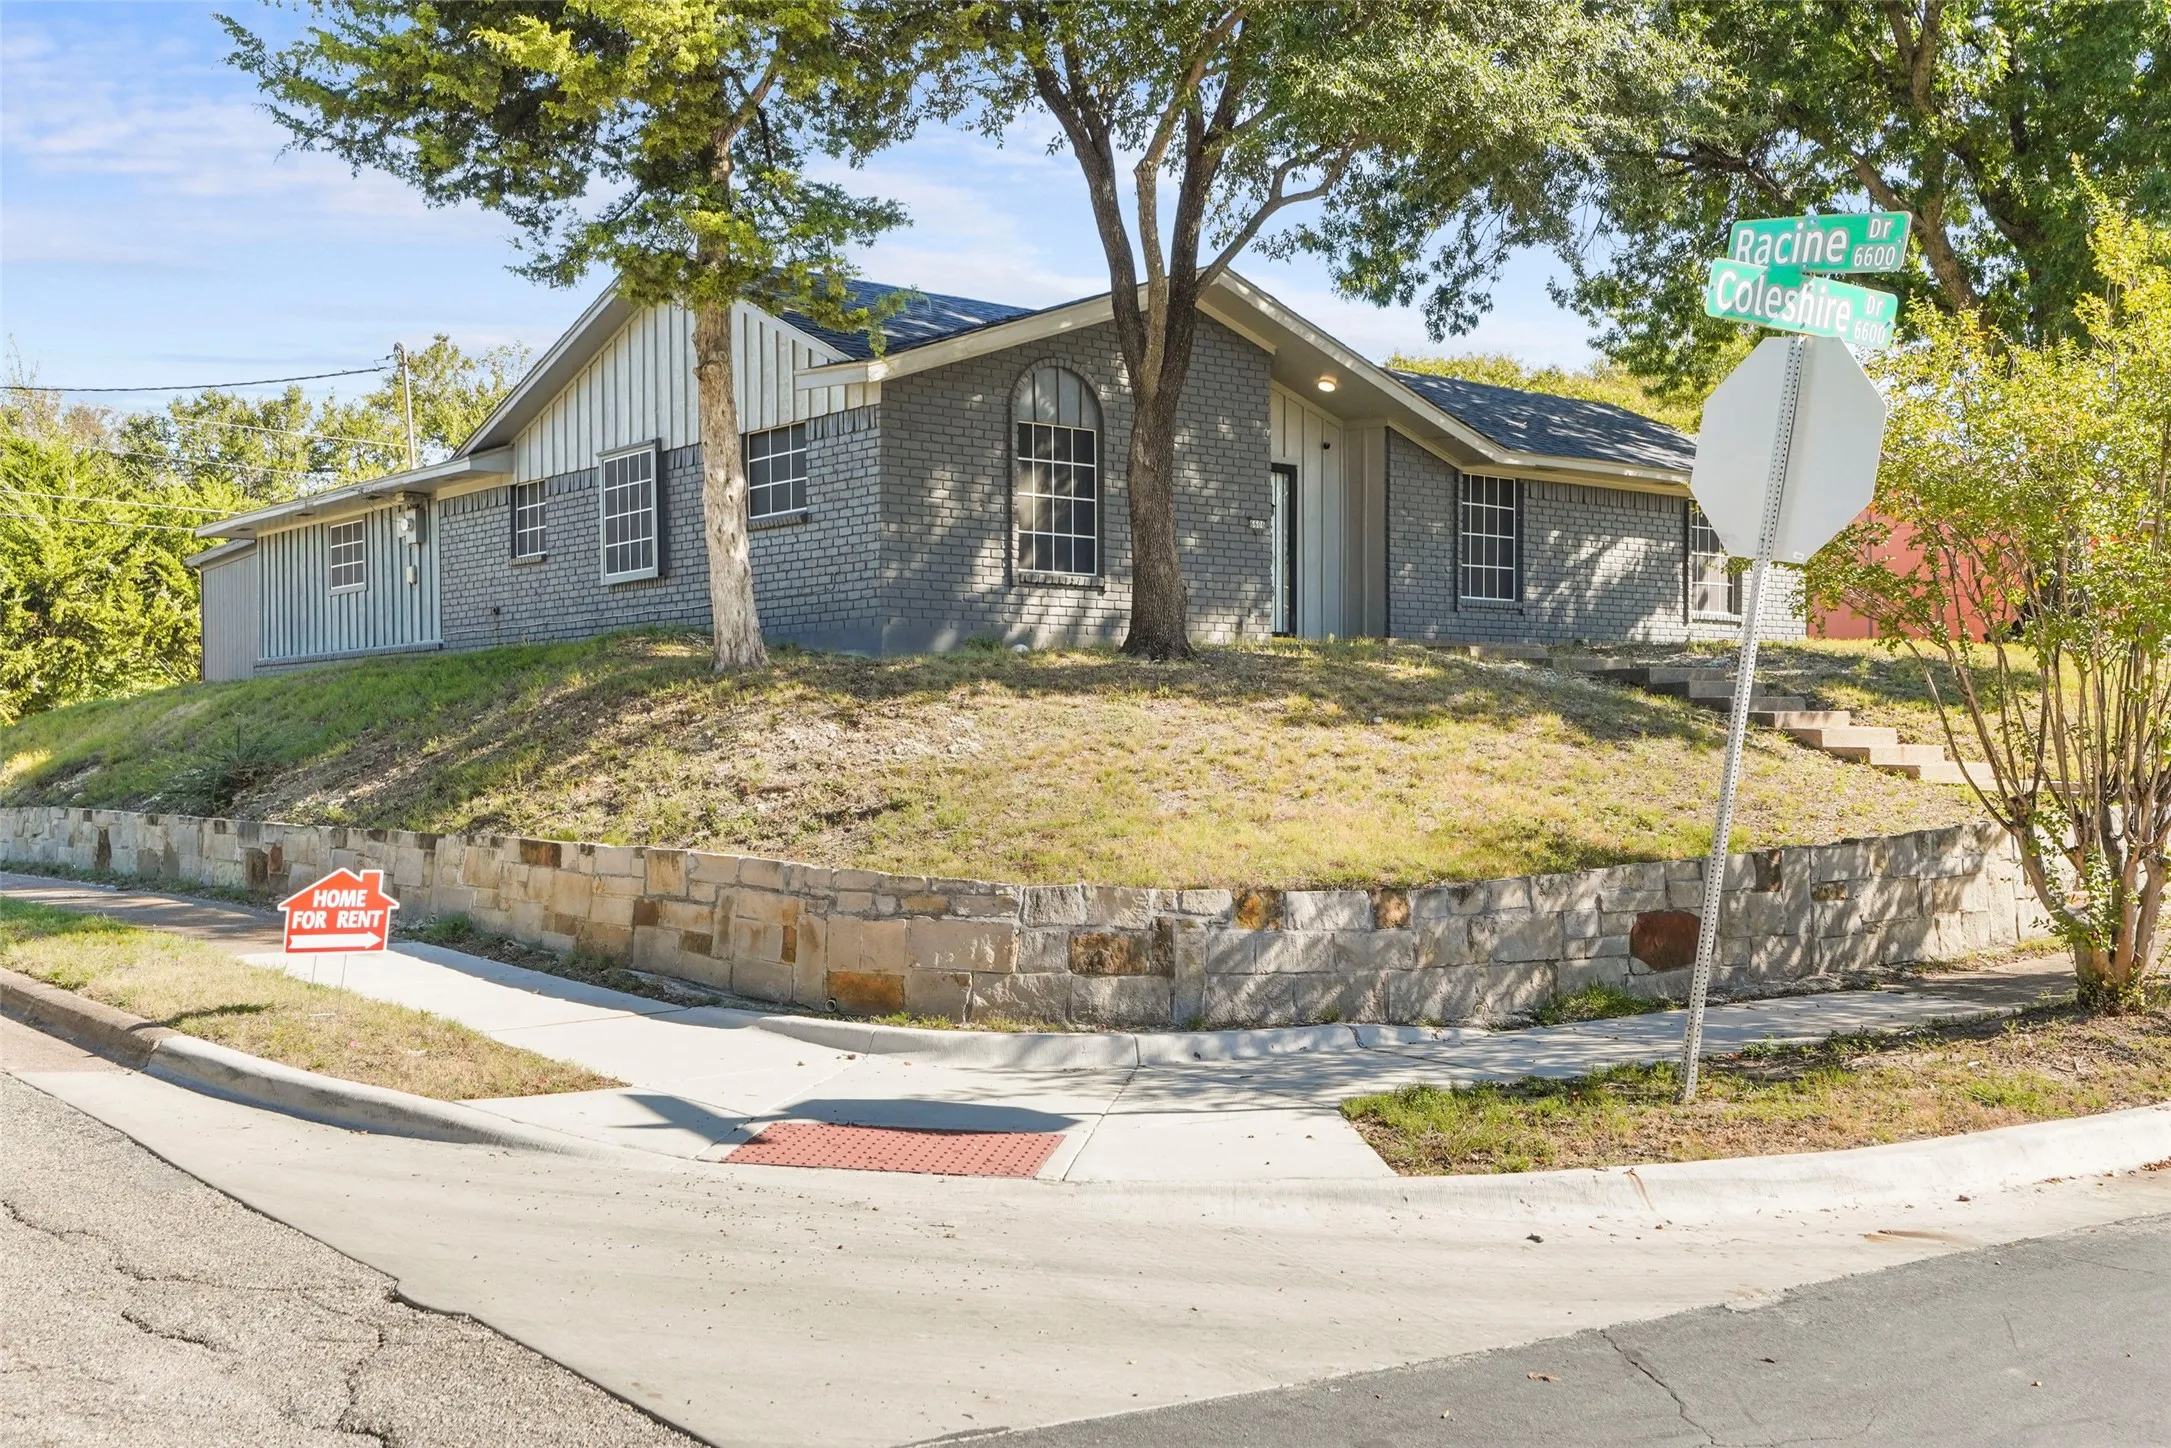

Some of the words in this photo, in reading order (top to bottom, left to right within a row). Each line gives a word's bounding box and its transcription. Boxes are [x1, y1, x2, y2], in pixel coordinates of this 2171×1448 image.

[1735, 222, 1847, 266] Racine
[1868, 218, 1892, 239] Dr
[1853, 246, 1896, 270] 6600
[1716, 271, 1851, 332] Coleshire
[1865, 295, 1884, 317] Dr
[1853, 321, 1886, 345] 6600
[312, 889, 368, 908] HOME
[291, 910, 327, 930] FOR
[336, 909, 384, 929] RENT
